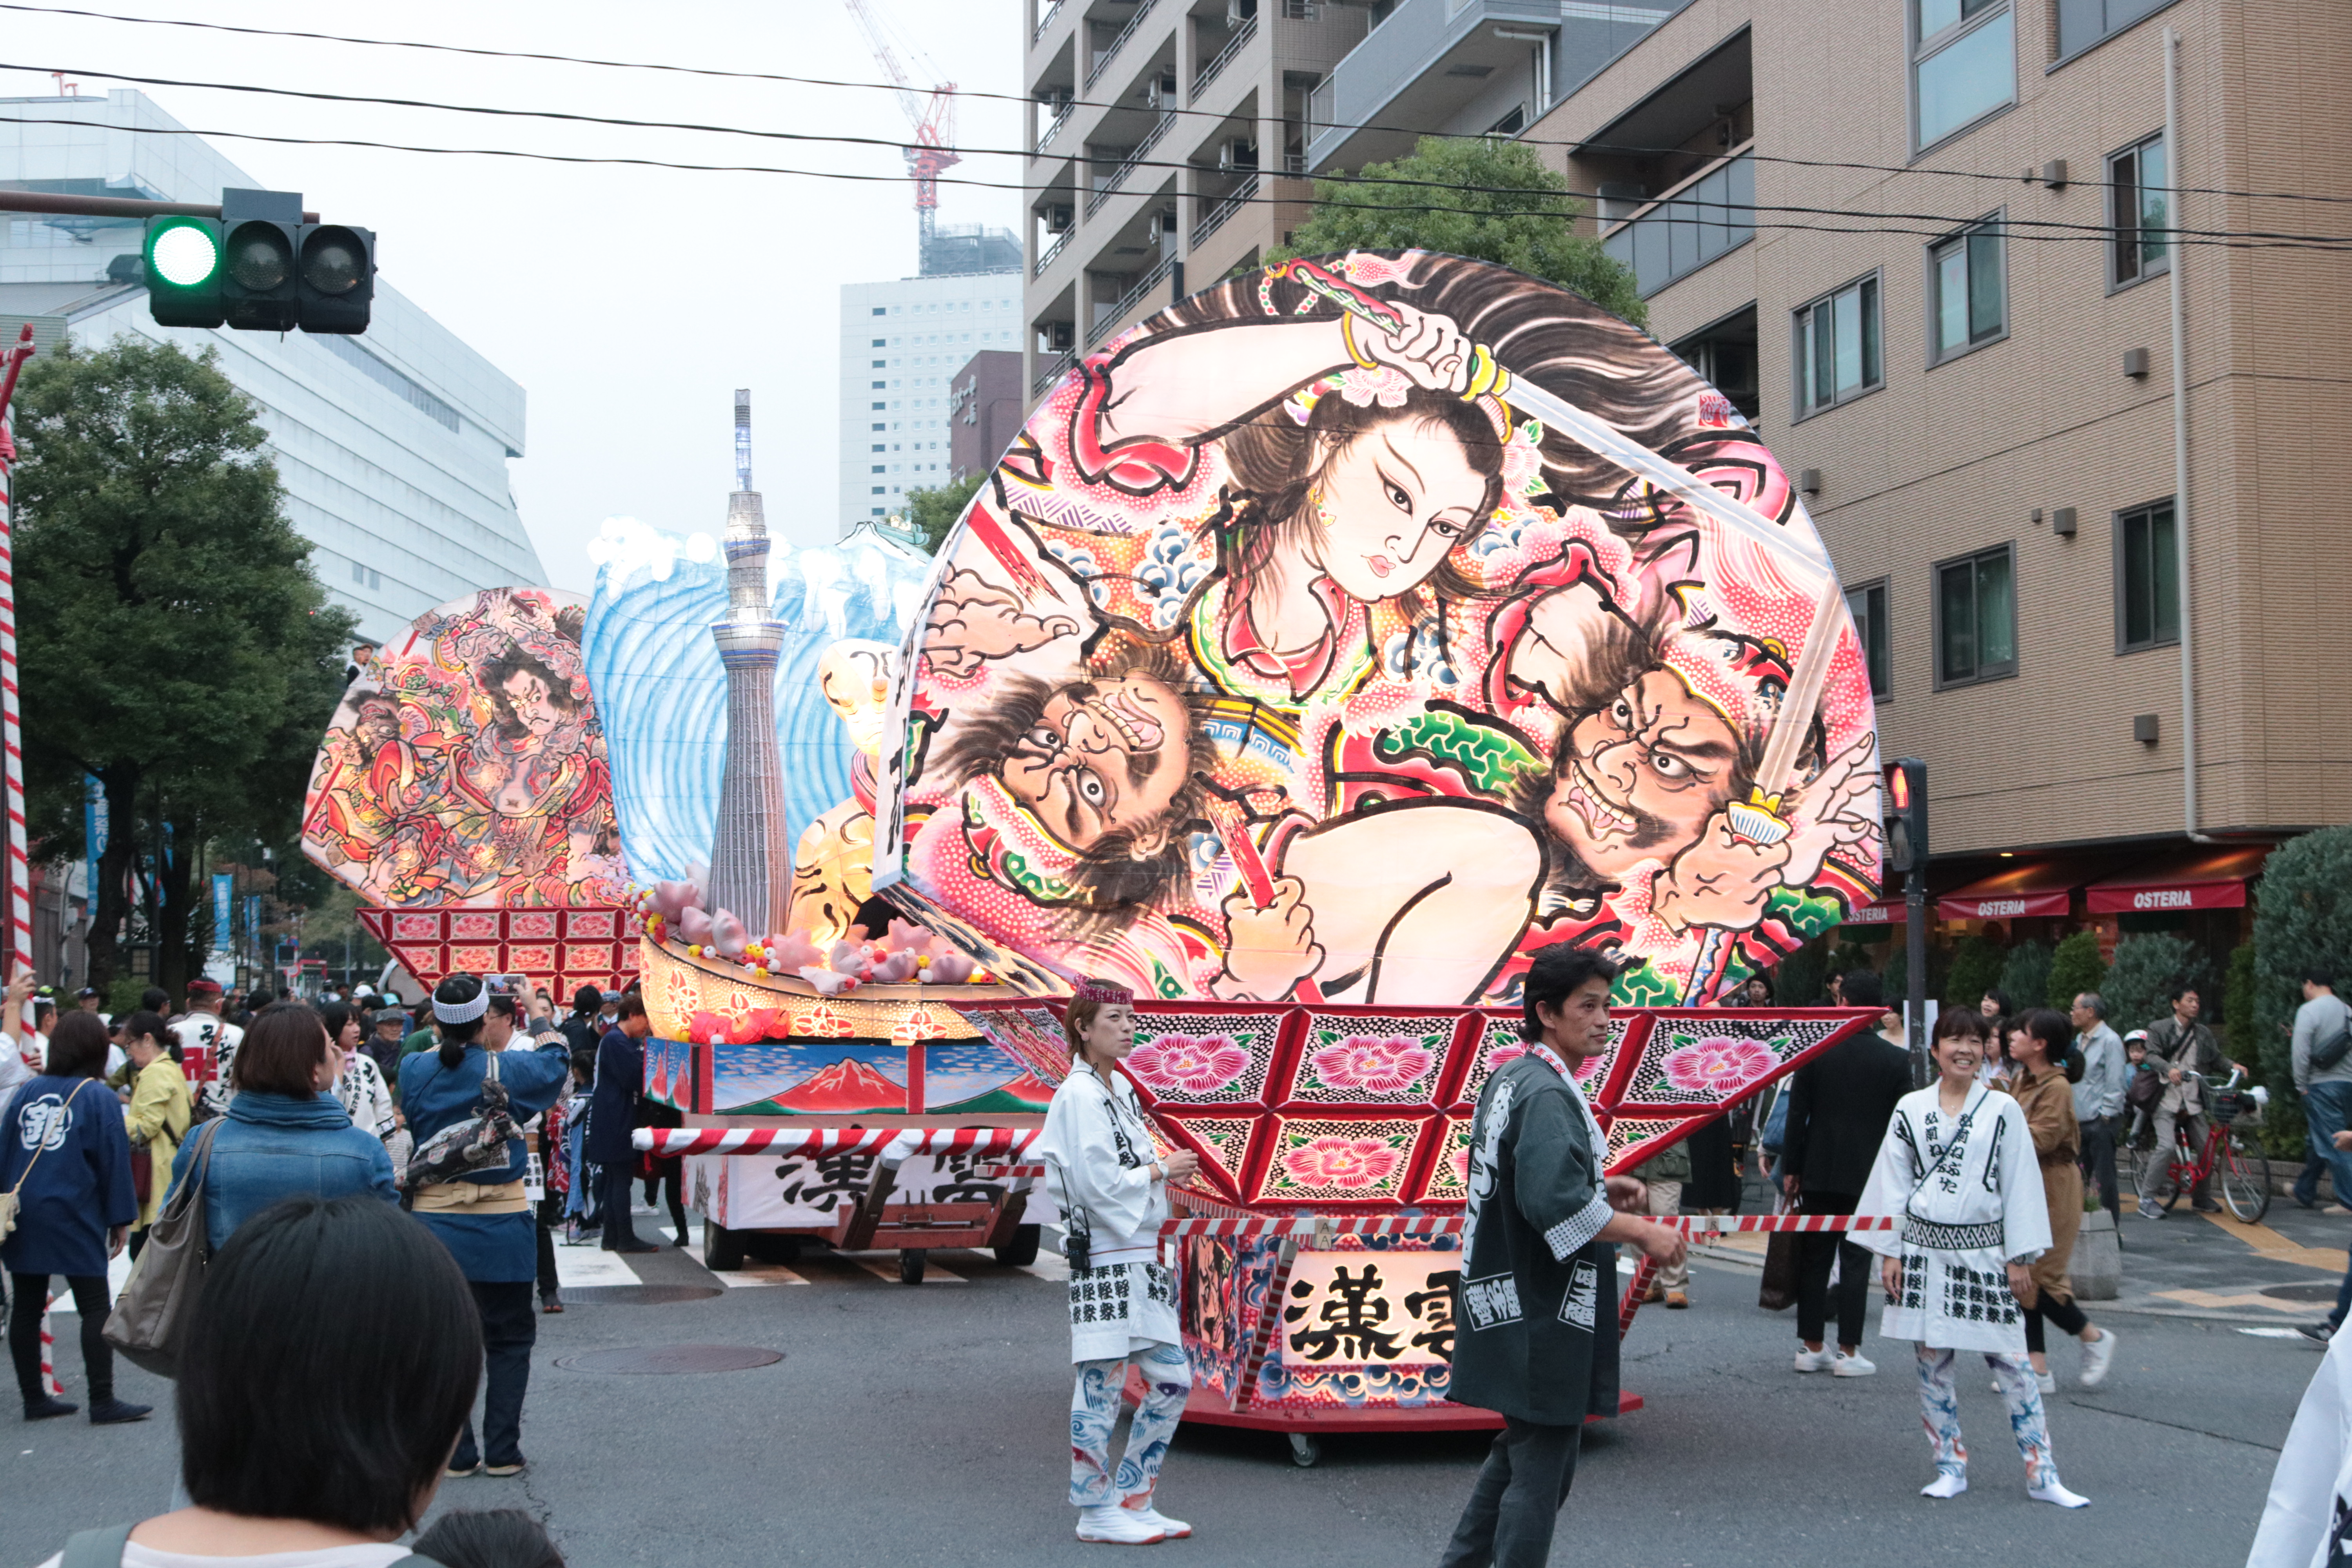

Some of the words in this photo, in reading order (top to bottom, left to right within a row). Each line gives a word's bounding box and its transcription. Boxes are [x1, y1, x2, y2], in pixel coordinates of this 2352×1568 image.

[1978, 900, 2025, 916] OSTERIA
[2134, 890, 2192, 908] OSTERIA
[1320, 1223, 1329, 1233] A
[1320, 1235, 1330, 1248] A
[1907, 1254, 1923, 1308] 津軽衆
[1952, 1265, 1967, 1319] 津軽衆
[1968, 1268, 1984, 1321] 津軽衆
[1982, 1271, 2001, 1323] 津軽衆
